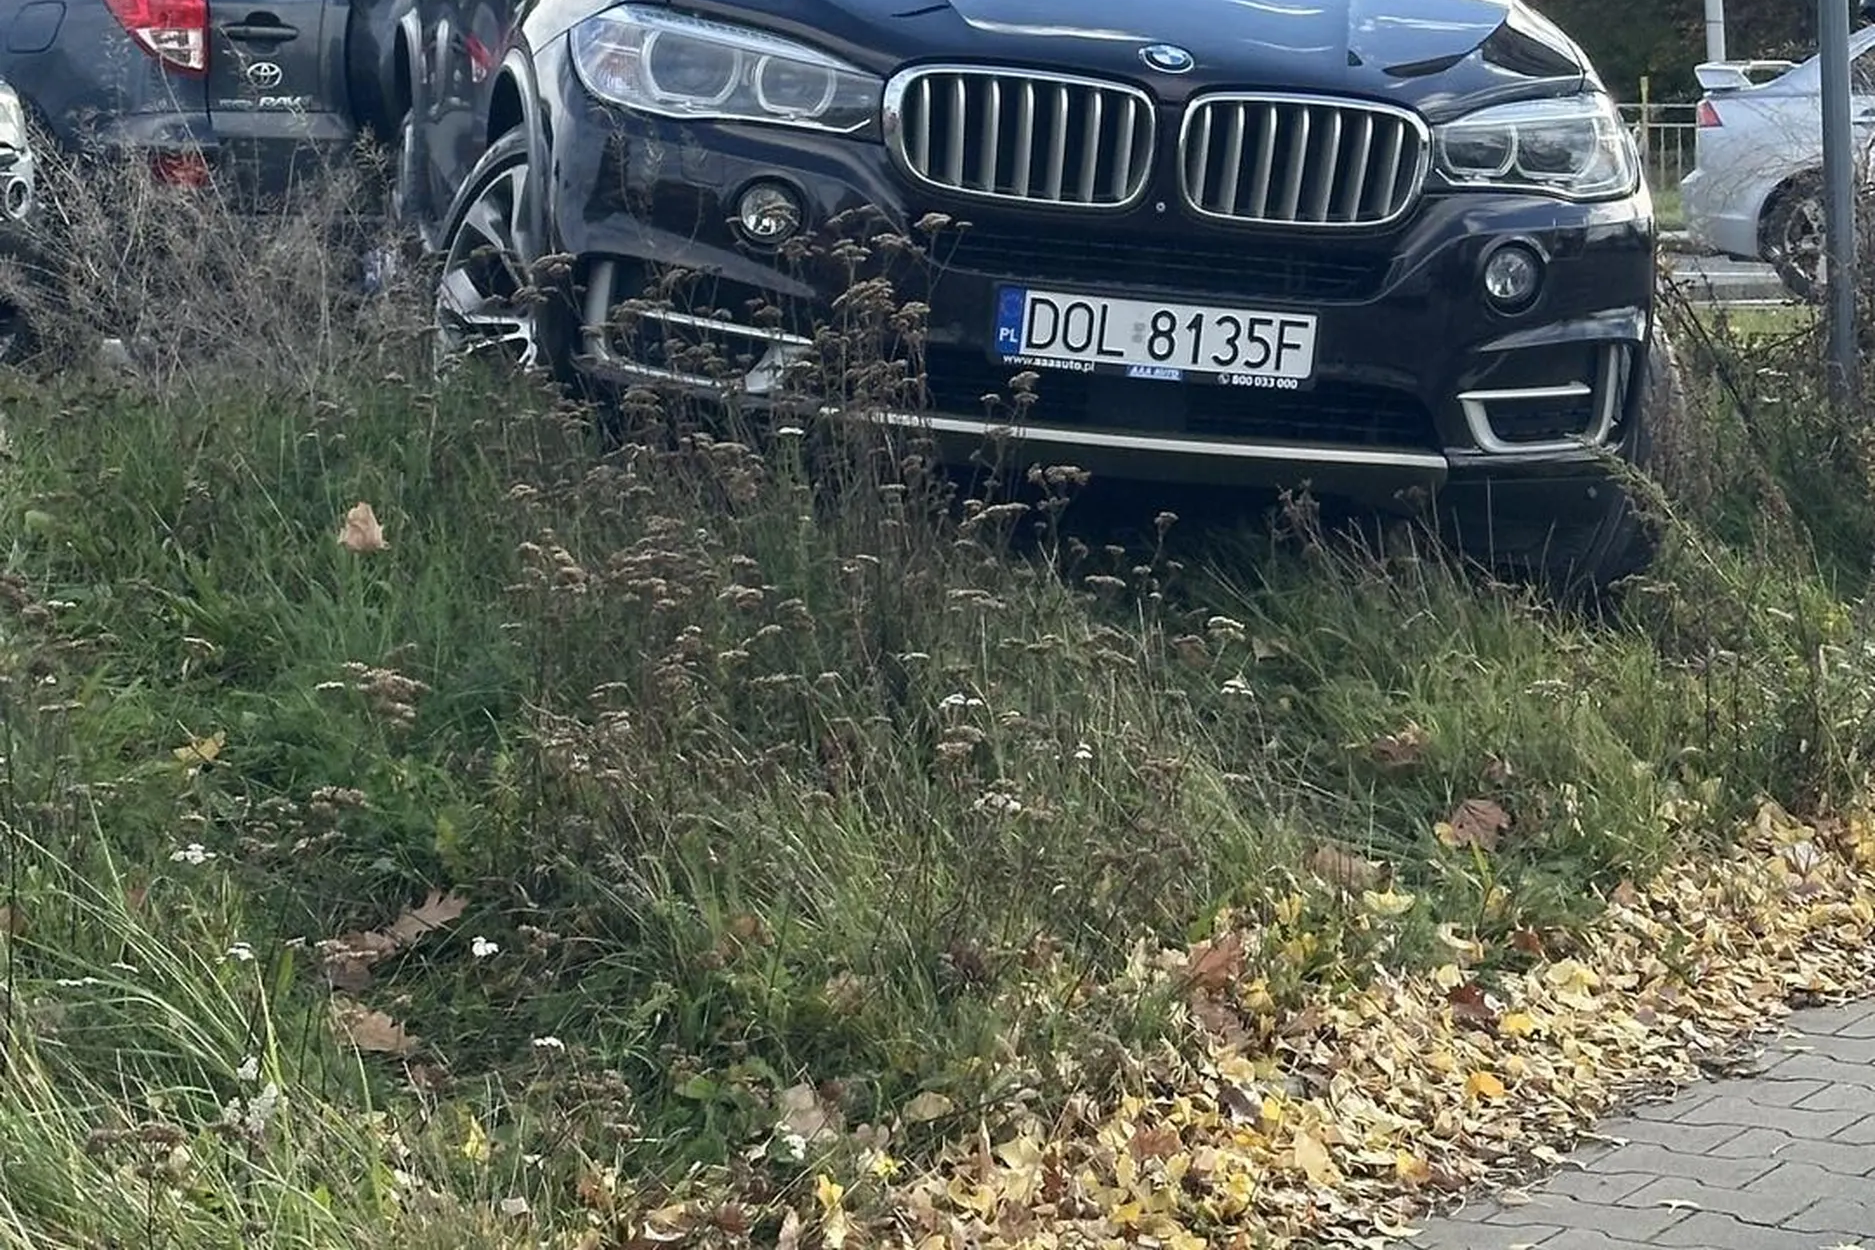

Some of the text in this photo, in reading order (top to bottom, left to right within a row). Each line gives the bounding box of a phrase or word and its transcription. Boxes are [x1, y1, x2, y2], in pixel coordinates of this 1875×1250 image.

[999, 327, 1018, 343] PL
[1026, 297, 1310, 371] DOL 8135F
[1231, 374, 1298, 389] 800 033 000
